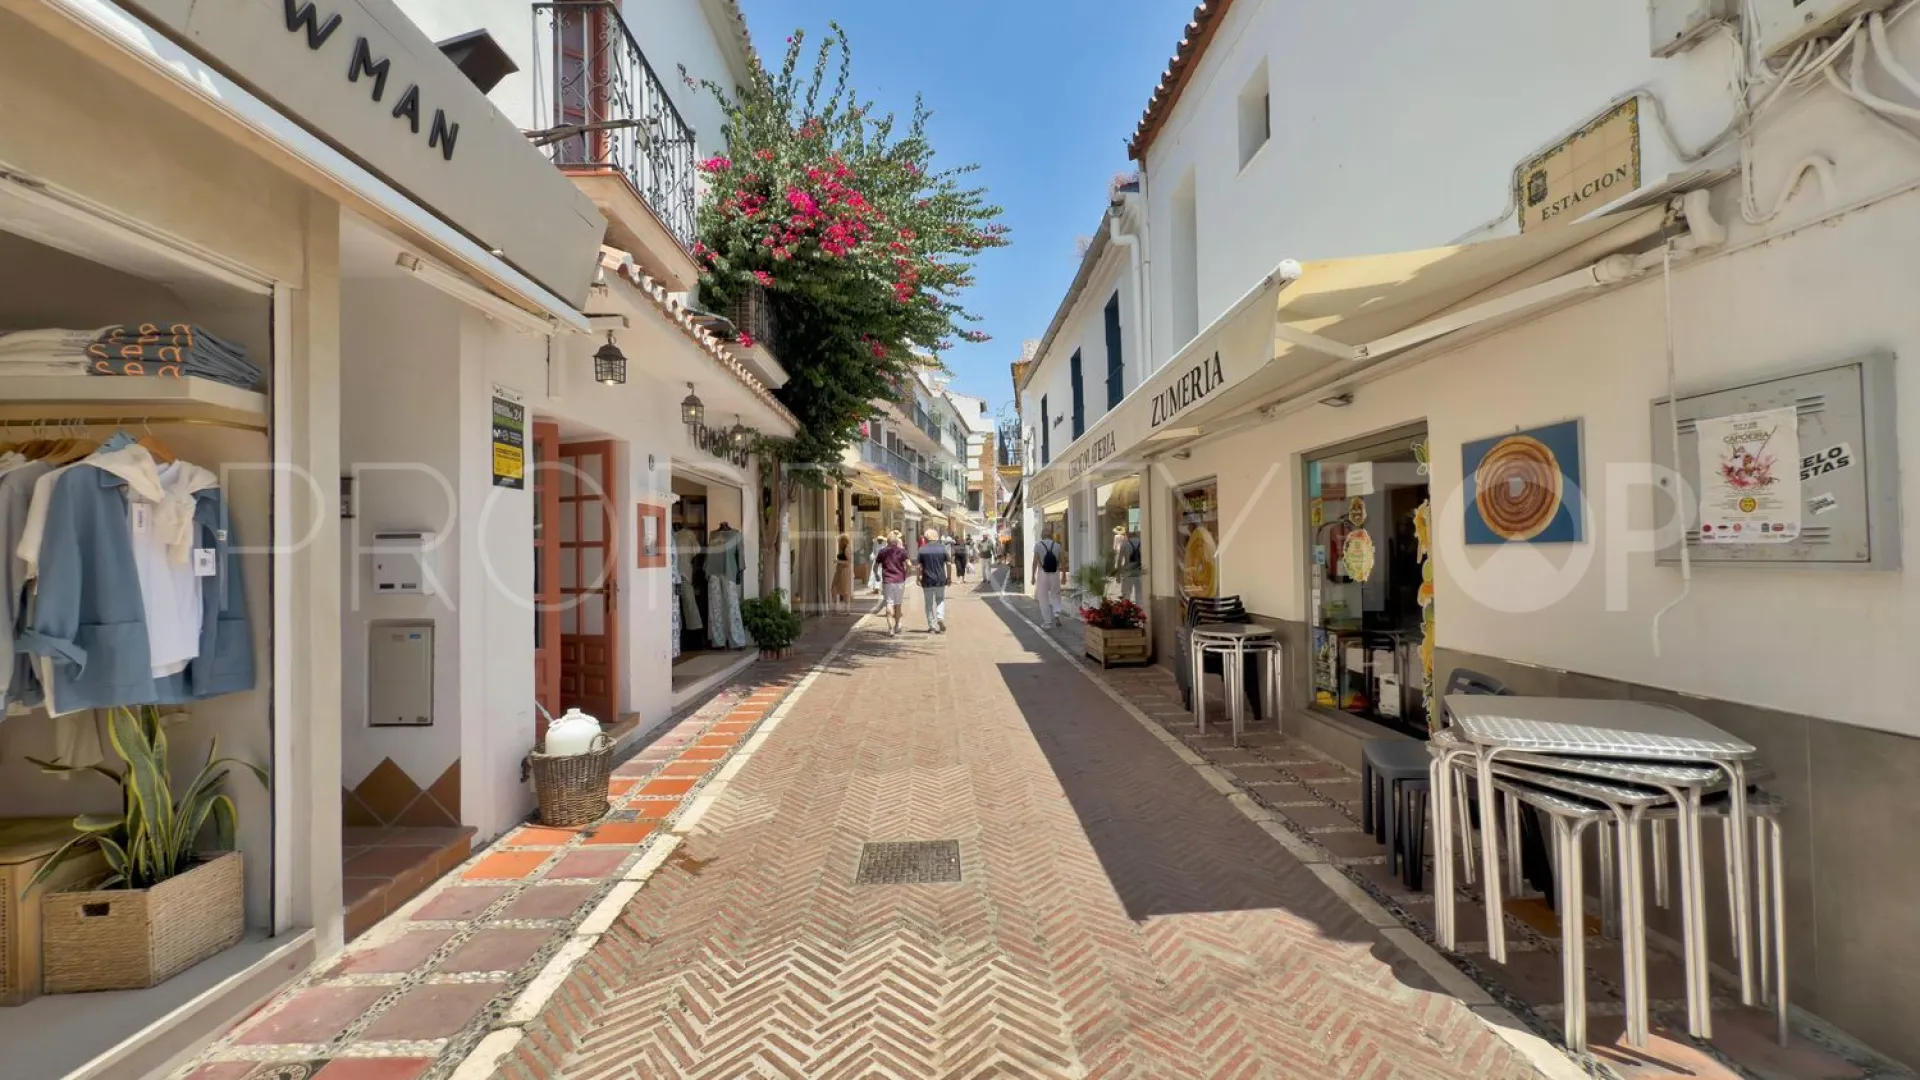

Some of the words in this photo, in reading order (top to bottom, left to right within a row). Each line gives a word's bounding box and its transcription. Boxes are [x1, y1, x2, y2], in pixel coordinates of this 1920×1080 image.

[1541, 164, 1628, 220] ESTACION
[1152, 349, 1224, 428] ZUMERIA
[1800, 446, 1842, 469] ELO
